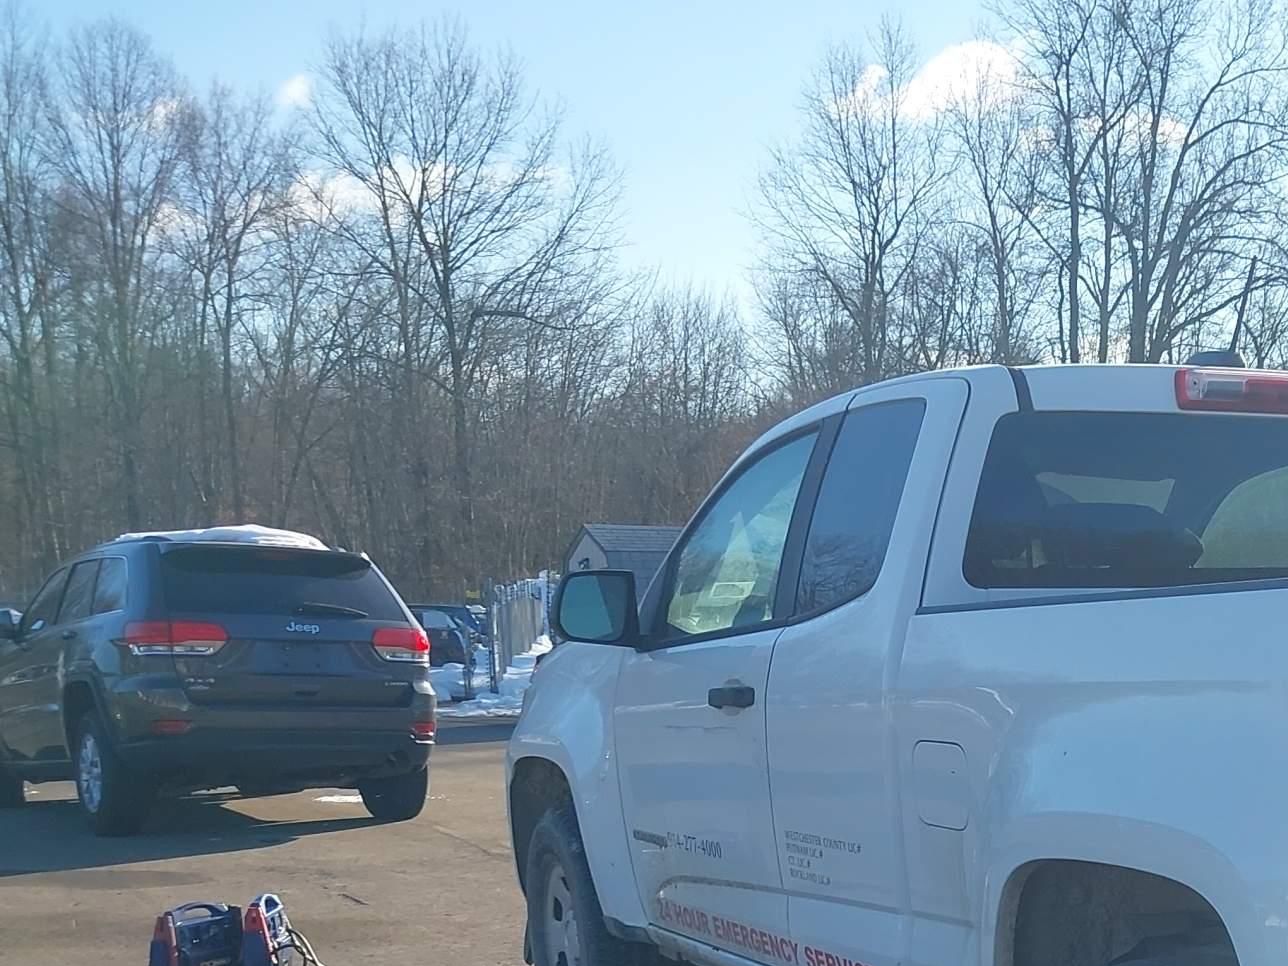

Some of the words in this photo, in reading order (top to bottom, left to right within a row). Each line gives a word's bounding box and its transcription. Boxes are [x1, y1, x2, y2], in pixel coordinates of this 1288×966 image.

[286, 621, 319, 634] Jeep
[658, 900, 674, 922] 24
[675, 903, 711, 935] HOUR
[714, 916, 801, 966] EMERGENCY
